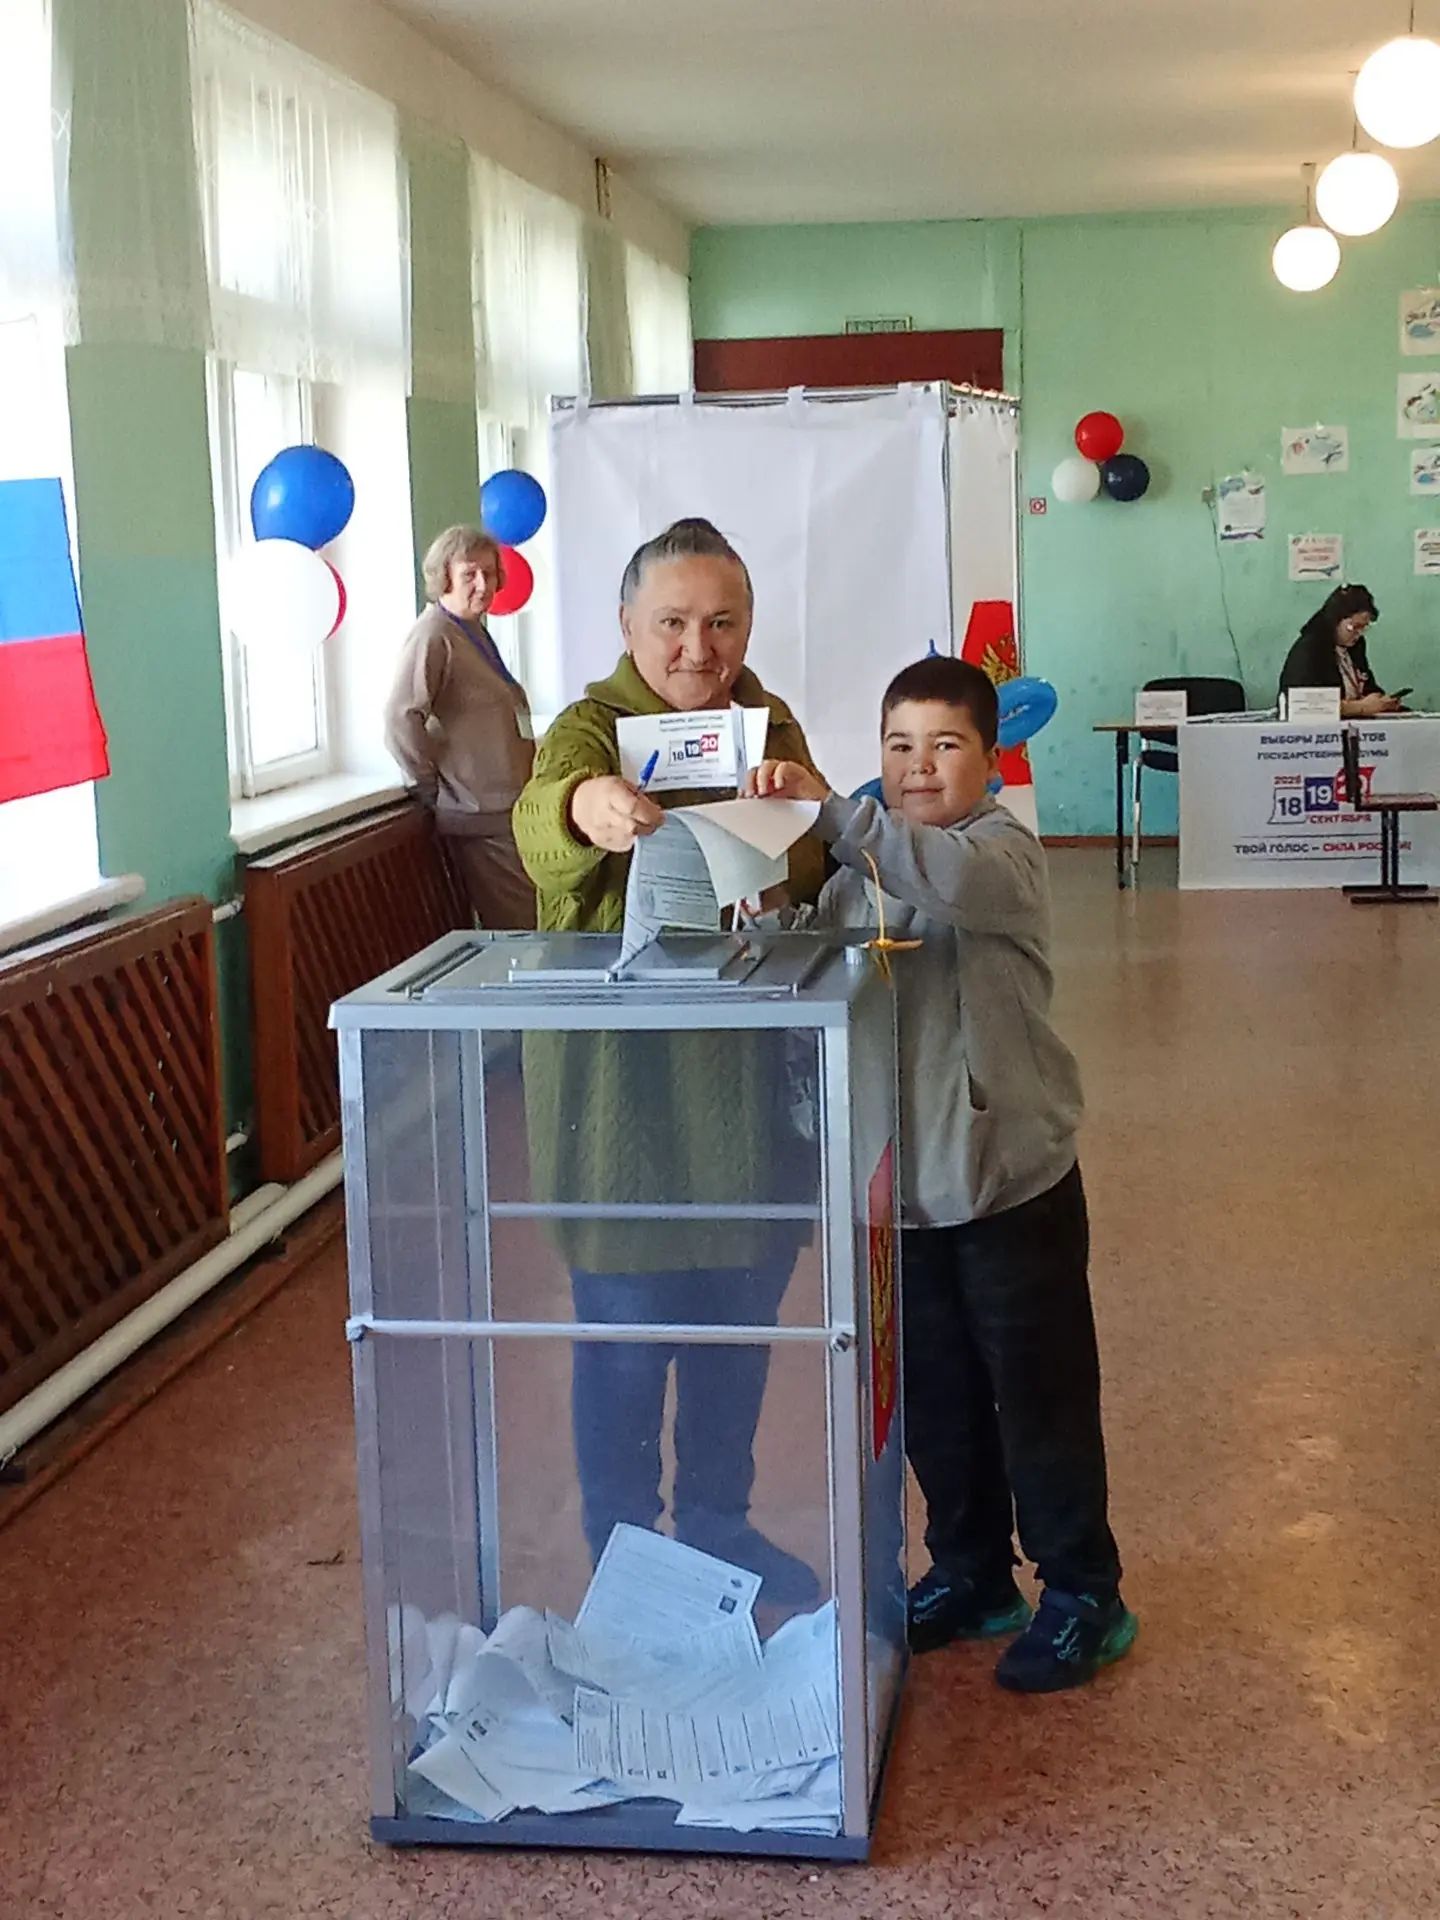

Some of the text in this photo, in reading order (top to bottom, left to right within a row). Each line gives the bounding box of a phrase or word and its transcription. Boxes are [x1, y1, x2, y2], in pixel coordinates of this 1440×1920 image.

[701, 736, 717, 749] 20
[1260, 732, 1386, 745] ВЫБОРЫ ДЕПТОВ
[1278, 796, 1303, 816] 18
[1306, 784, 1333, 805] 19
[1233, 842, 1267, 854] ТВОЙ
[1269, 842, 1309, 854] ГОЛОС
[1322, 841, 1355, 852] СИЛА
